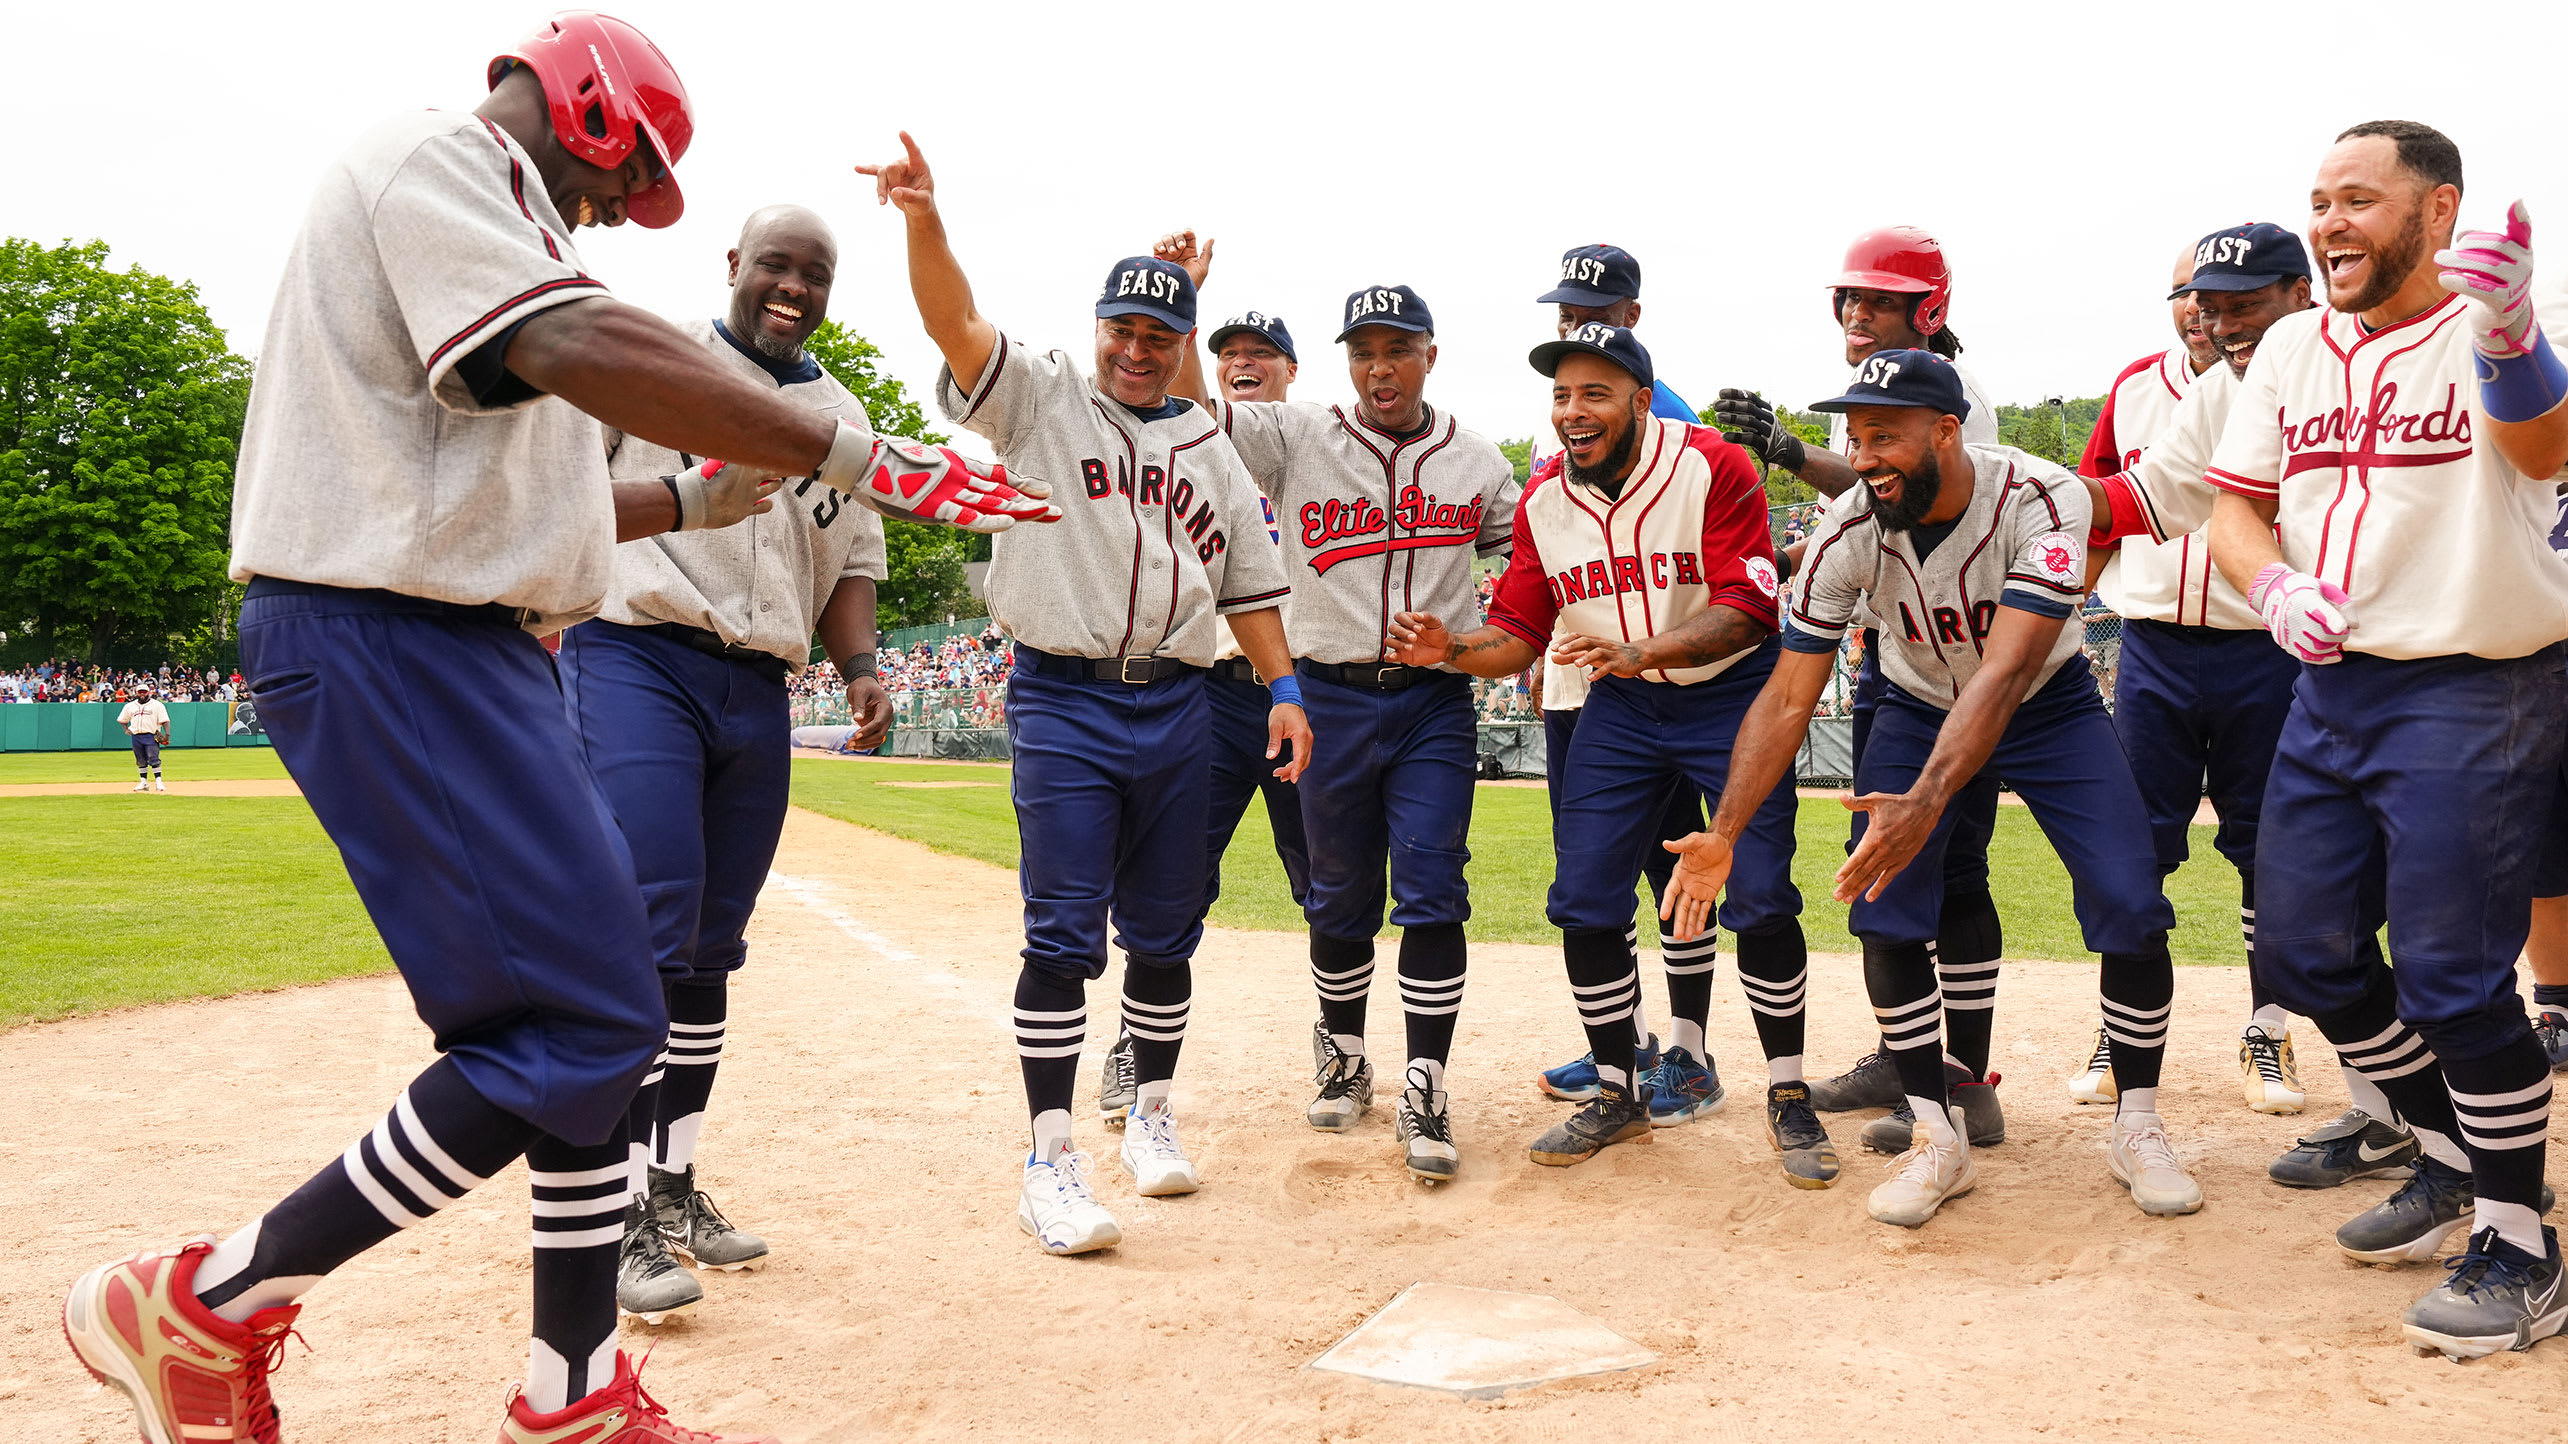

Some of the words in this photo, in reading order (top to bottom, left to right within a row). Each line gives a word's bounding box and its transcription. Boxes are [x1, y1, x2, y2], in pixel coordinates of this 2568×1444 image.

[2193, 236, 2252, 274] EAST
[1116, 268, 1181, 305] EAST
[1225, 311, 1275, 332] AST
[1350, 289, 1403, 324] EAST
[1566, 324, 1616, 348] AST
[2278, 381, 2472, 454] rawfords
[1299, 498, 1388, 549] Elite
[1394, 484, 1484, 531] Giants
